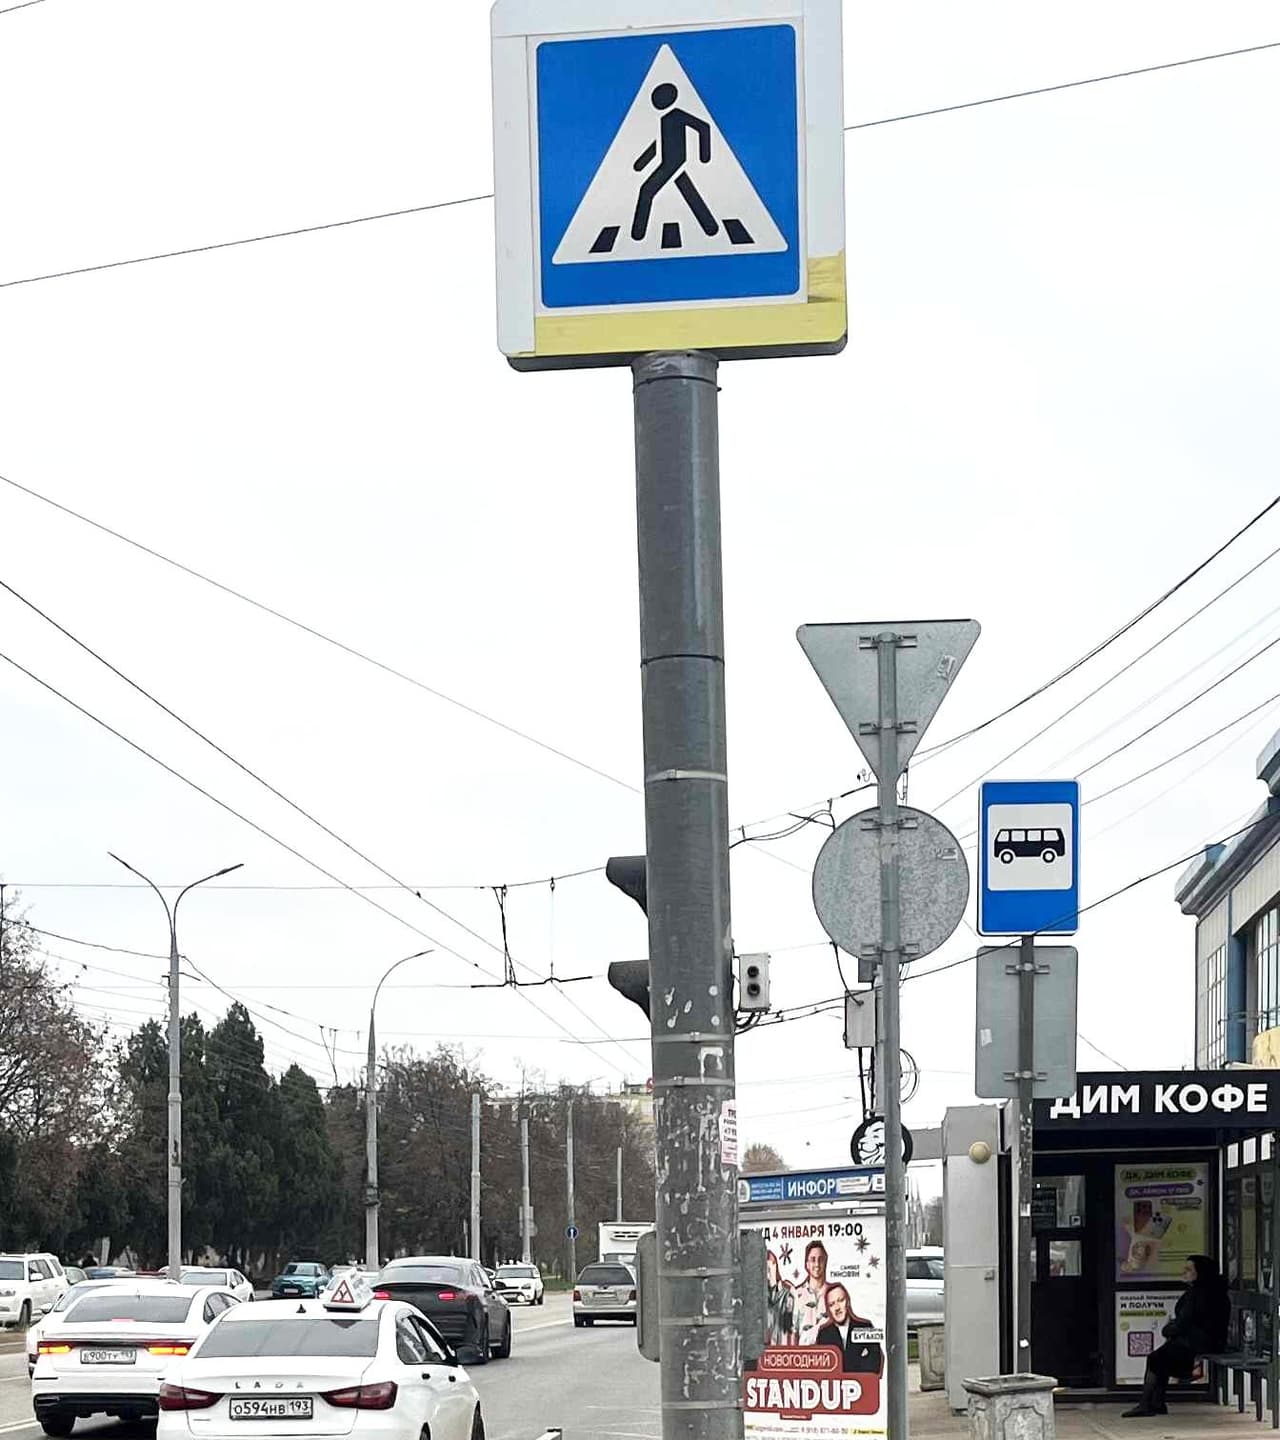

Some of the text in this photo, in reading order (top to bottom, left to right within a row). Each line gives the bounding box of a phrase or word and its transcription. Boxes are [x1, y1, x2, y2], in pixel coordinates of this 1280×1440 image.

[1154, 1083, 1268, 1113] КОФЕ
[787, 1179, 836, 1197] ИНФОР
[772, 1228, 779, 1240] 4
[781, 1225, 825, 1239] ЯНВАРЯ
[828, 1222, 863, 1237] 19:00
[764, 1352, 832, 1369] НОВОГОДНИЙ
[234, 1381, 304, 1389] LADA
[746, 1377, 862, 1411] STANDUP
[289, 1400, 310, 1411] 193
